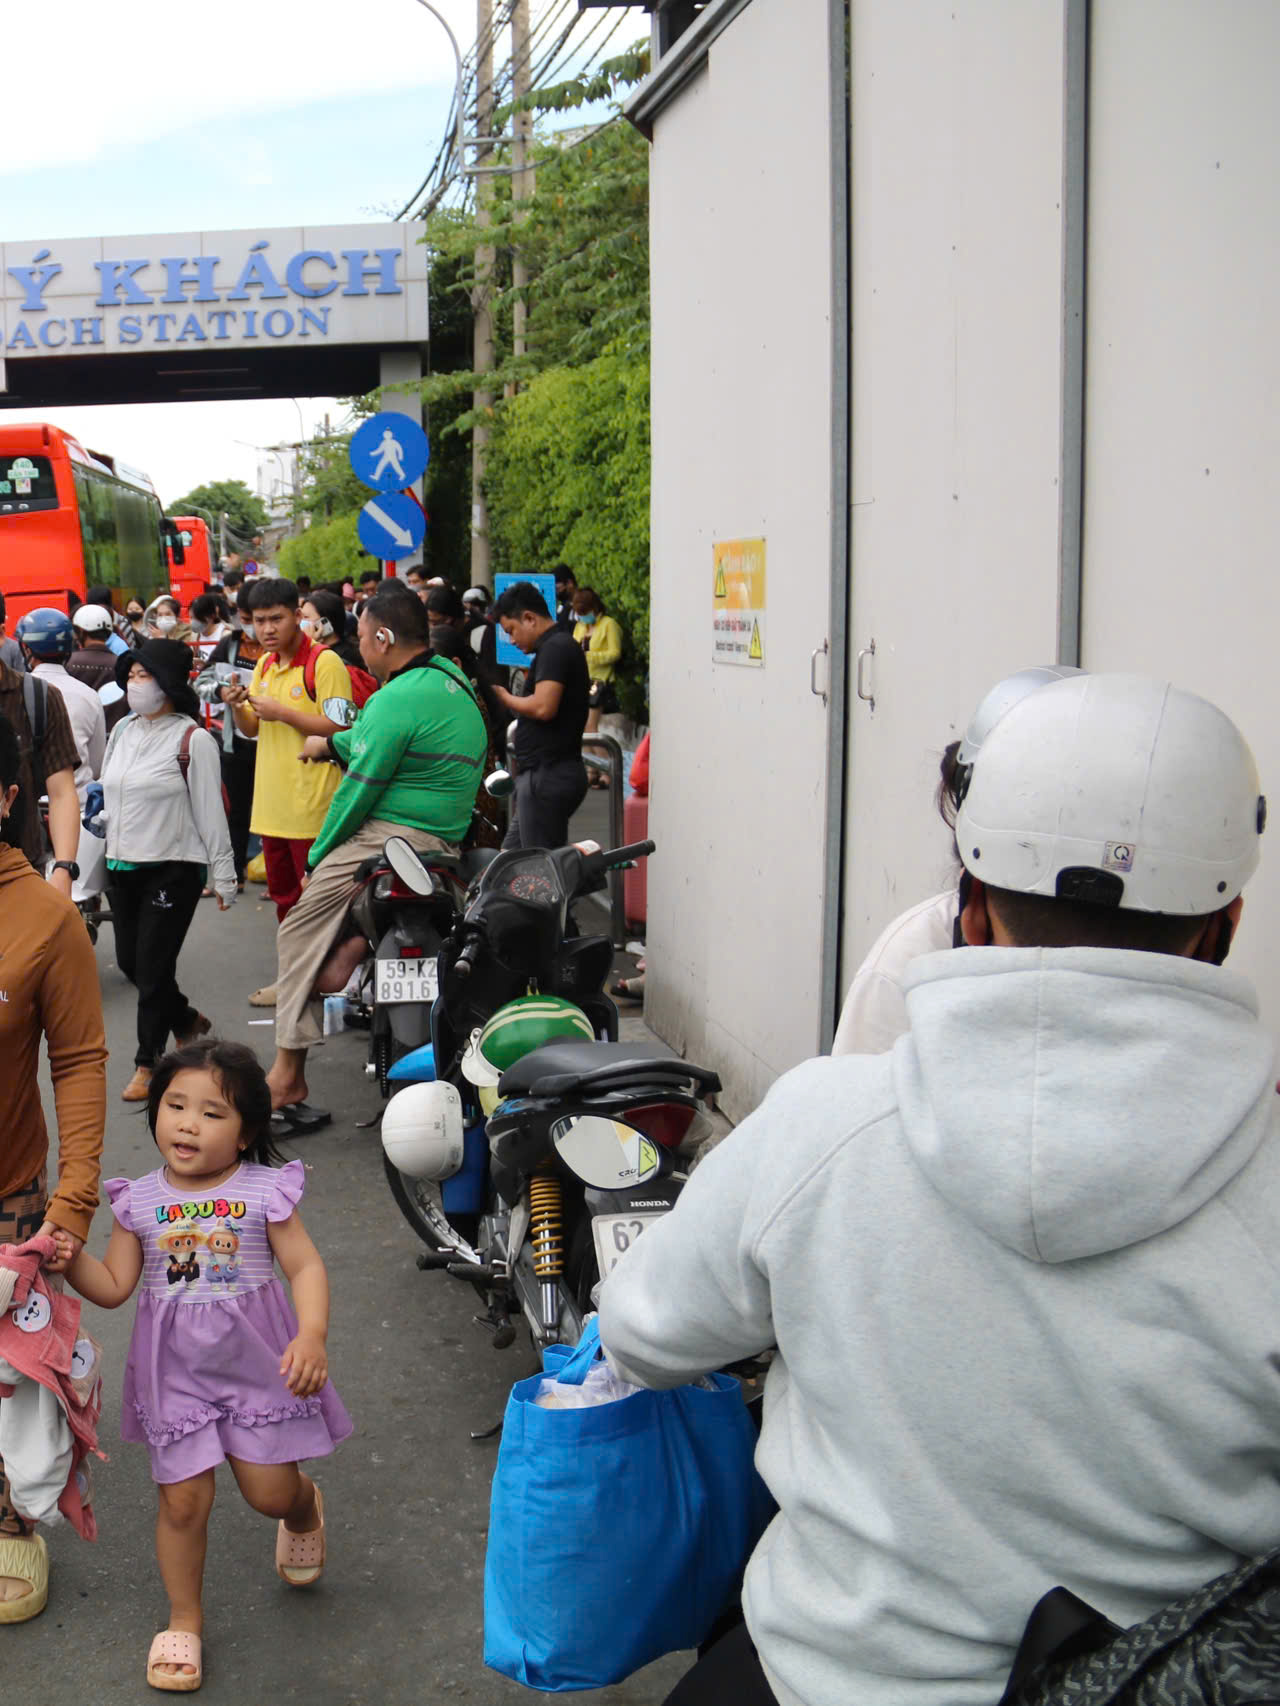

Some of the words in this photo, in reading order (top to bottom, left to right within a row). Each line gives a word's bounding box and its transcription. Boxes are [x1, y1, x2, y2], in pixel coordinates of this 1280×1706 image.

[94, 241, 403, 306] KHÁCH
[119, 306, 331, 344] STATION
[386, 959, 437, 979] 59-K2
[381, 980, 438, 1000] 891.6
[155, 1199, 246, 1224] LABUBU
